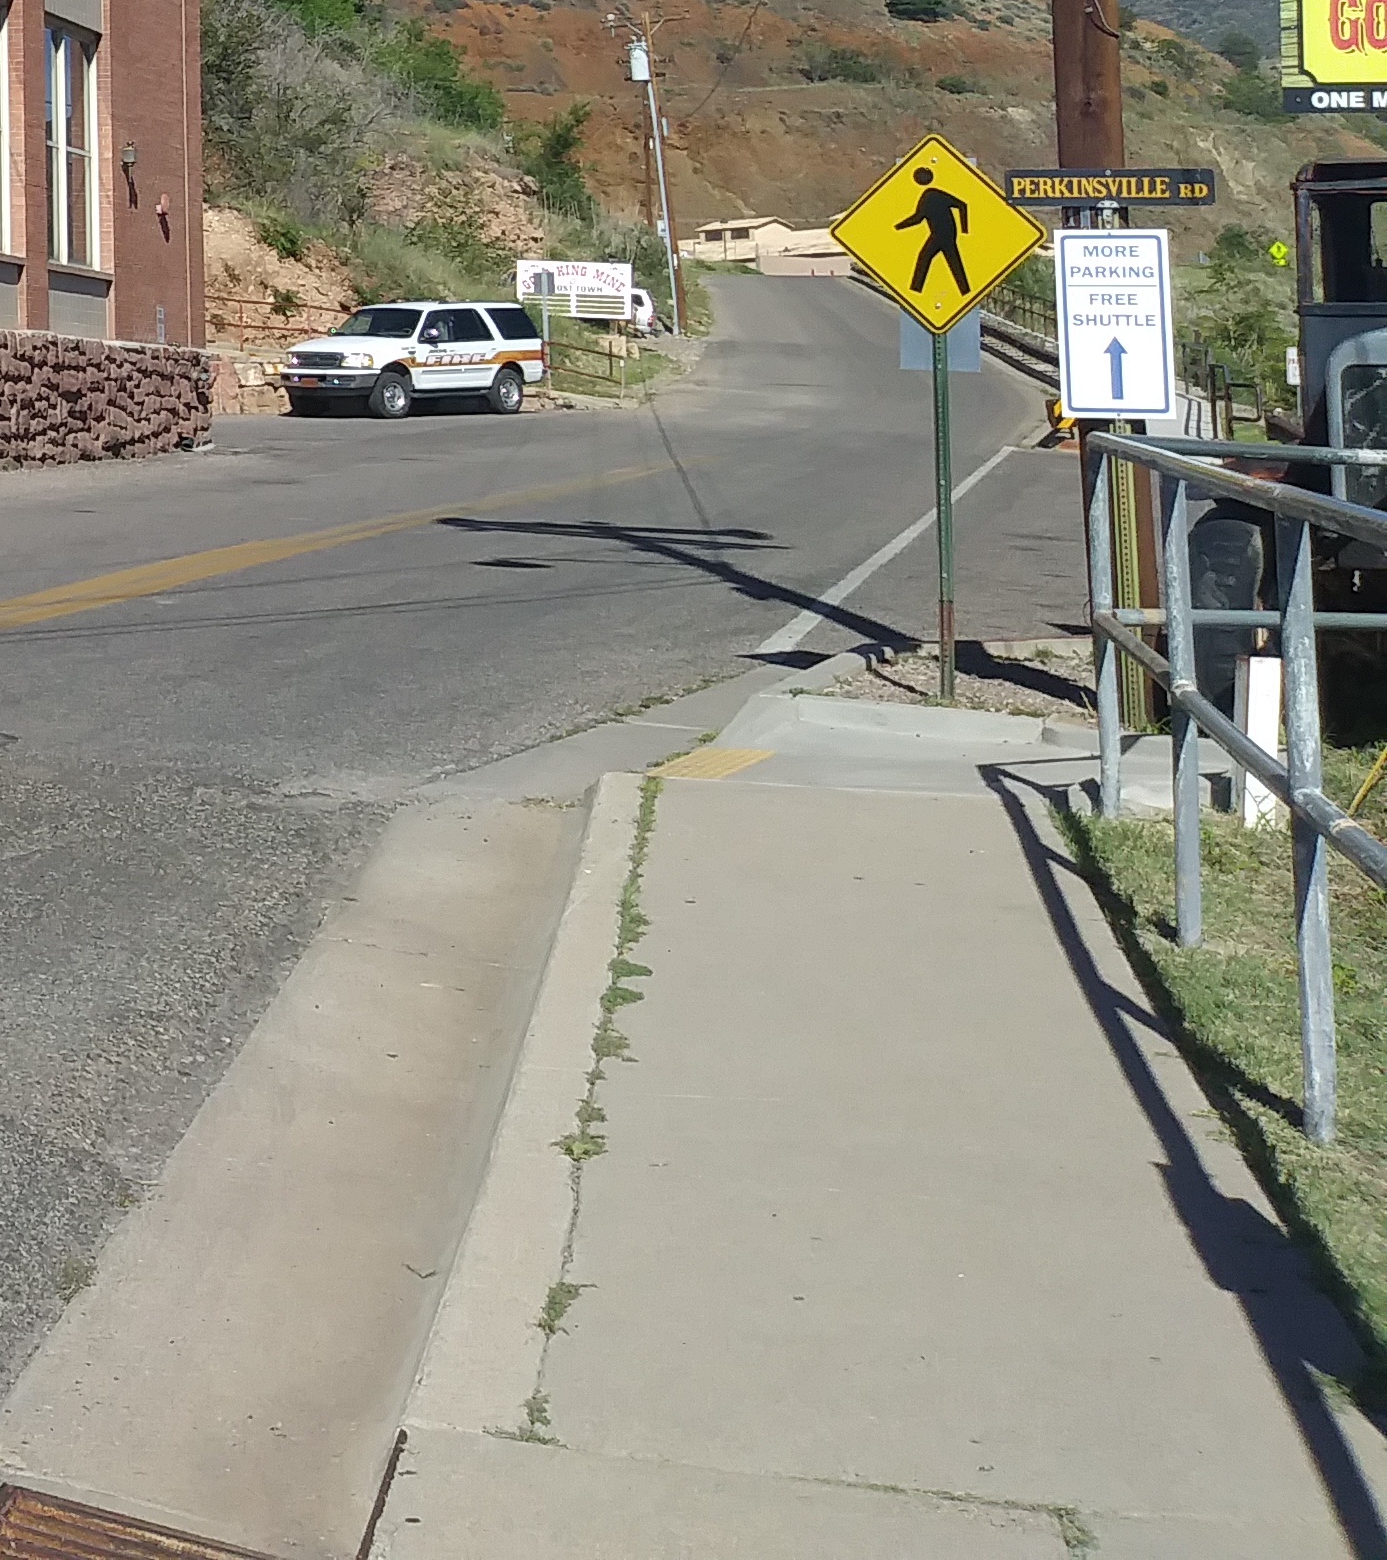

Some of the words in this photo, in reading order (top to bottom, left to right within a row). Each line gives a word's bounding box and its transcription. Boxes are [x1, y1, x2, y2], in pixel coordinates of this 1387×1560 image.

[1310, 91, 1366, 109] ONE
[1010, 176, 1172, 199] PERKINSVILLE
[1178, 183, 1209, 199] RD
[1083, 245, 1140, 258] MORE
[556, 264, 587, 277] KING
[593, 268, 626, 293] MINE
[1070, 266, 1155, 279] PARKING
[576, 285, 603, 293] TOWN
[1089, 293, 1139, 306] FREE
[1072, 314, 1157, 327] SHUTTLE
[425, 352, 487, 365] FIRE
